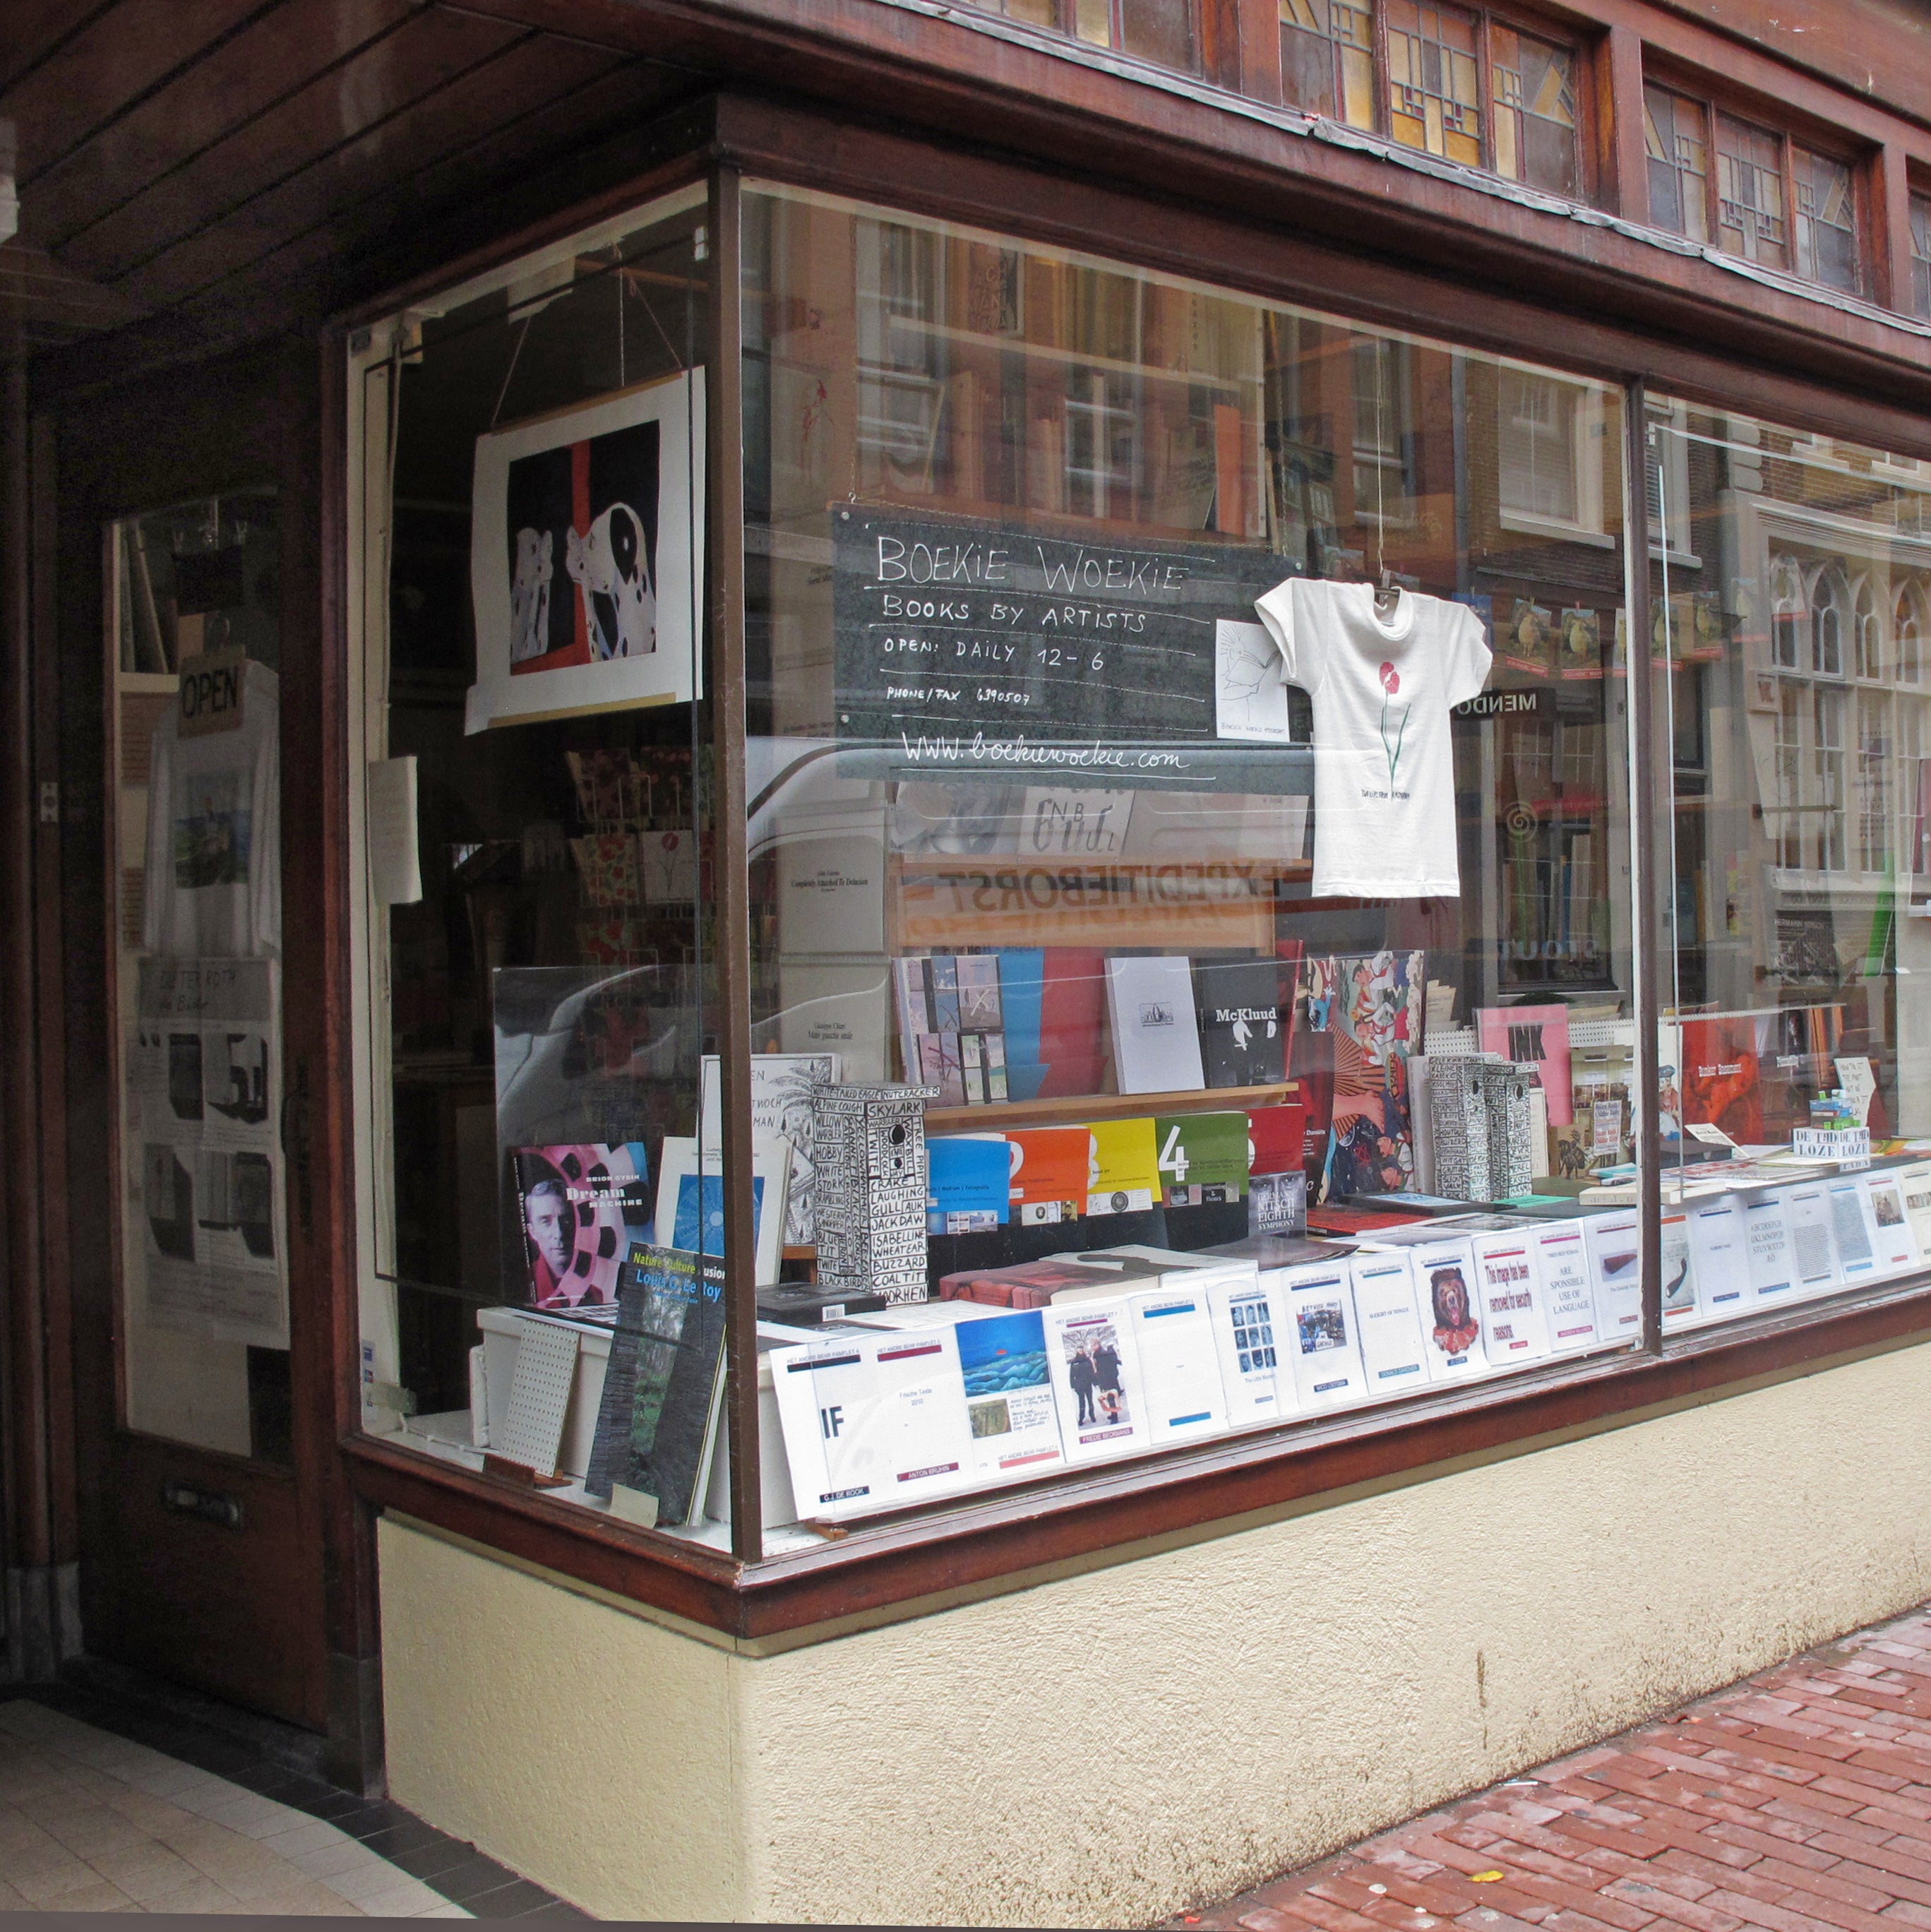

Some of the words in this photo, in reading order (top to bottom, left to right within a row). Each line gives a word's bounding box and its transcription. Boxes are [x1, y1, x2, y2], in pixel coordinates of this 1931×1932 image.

[883, 595, 969, 620] BOOKS
[991, 604, 1024, 625] BY
[885, 638, 938, 653] OPEN:
[1092, 652, 1104, 670] 6
[182, 666, 238, 718] OPEN
[887, 687, 961, 701] PHONE/FAX
[977, 688, 1031, 706] 6390507
[1216, 1007, 1277, 1022] McKluud
[883, 1087, 939, 1099] NUTCRACKER
[815, 1099, 837, 1111] ALPINE
[868, 1102, 921, 1118] SKYLARK
[753, 1116, 775, 1128] MAN
[815, 1115, 842, 1128] WILLOW
[914, 1119, 923, 1151] TREE
[1796, 1131, 1811, 1142] DE
[1841, 1131, 1851, 1142] DE
[903, 1117, 914, 1173] WAXBILL
[1799, 1144, 1835, 1157] LOZE
[1843, 1143, 1867, 1157] LOZE
[816, 1147, 842, 1159] HOBBY
[868, 1132, 878, 1173] TWITE
[1159, 1125, 1189, 1181] 4
[816, 1165, 842, 1179] WHITE
[818, 1179, 844, 1191] STORK
[871, 1178, 909, 1192] CRAKE
[566, 1188, 626, 1200] Dream
[871, 1188, 923, 1205] LAUGHING
[589, 1199, 643, 1208] MACHINE
[871, 1203, 901, 1216] GULL
[906, 1203, 923, 1211] AUK
[1257, 1198, 1295, 1212] NITSCH
[1257, 1209, 1295, 1222] EIGHTH
[871, 1215, 924, 1232] JACKDAW
[1257, 1220, 1295, 1231] SYMPHONY
[818, 1232, 838, 1245] BLUE
[873, 1229, 925, 1248] ISABELLINE
[820, 1245, 834, 1256] TIT
[872, 1243, 926, 1258] WHEATEAR
[633, 1253, 662, 1268] Nature
[818, 1258, 837, 1270] TWITE
[873, 1257, 925, 1273] BUZZARD
[1485, 1263, 1497, 1284] This
[1497, 1264, 1510, 1287] image
[1509, 1261, 1519, 1281] has
[1560, 1266, 1572, 1275] ARE
[636, 1269, 666, 1289] Louis
[683, 1279, 696, 1294] Le
[873, 1273, 901, 1287] COAL
[902, 1272, 924, 1282] TIT
[1550, 1277, 1585, 1289] SPONSIBLE
[878, 1287, 926, 1304] OORHEN
[1489, 1291, 1509, 1313] removed
[1515, 1288, 1533, 1311] security
[1559, 1292, 1572, 1301] USE
[1572, 1289, 1581, 1298] OF
[1302, 1304, 1324, 1313] BETWEEN
[1553, 1301, 1590, 1314] LANGUAGE
[821, 1405, 844, 1438] IF
[1082, 1432, 1101, 1442] FREDIE
[1102, 1429, 1130, 1438] BECKMANS
[908, 1468, 928, 1479] ANTON
[847, 1489, 864, 1497] ROOK
